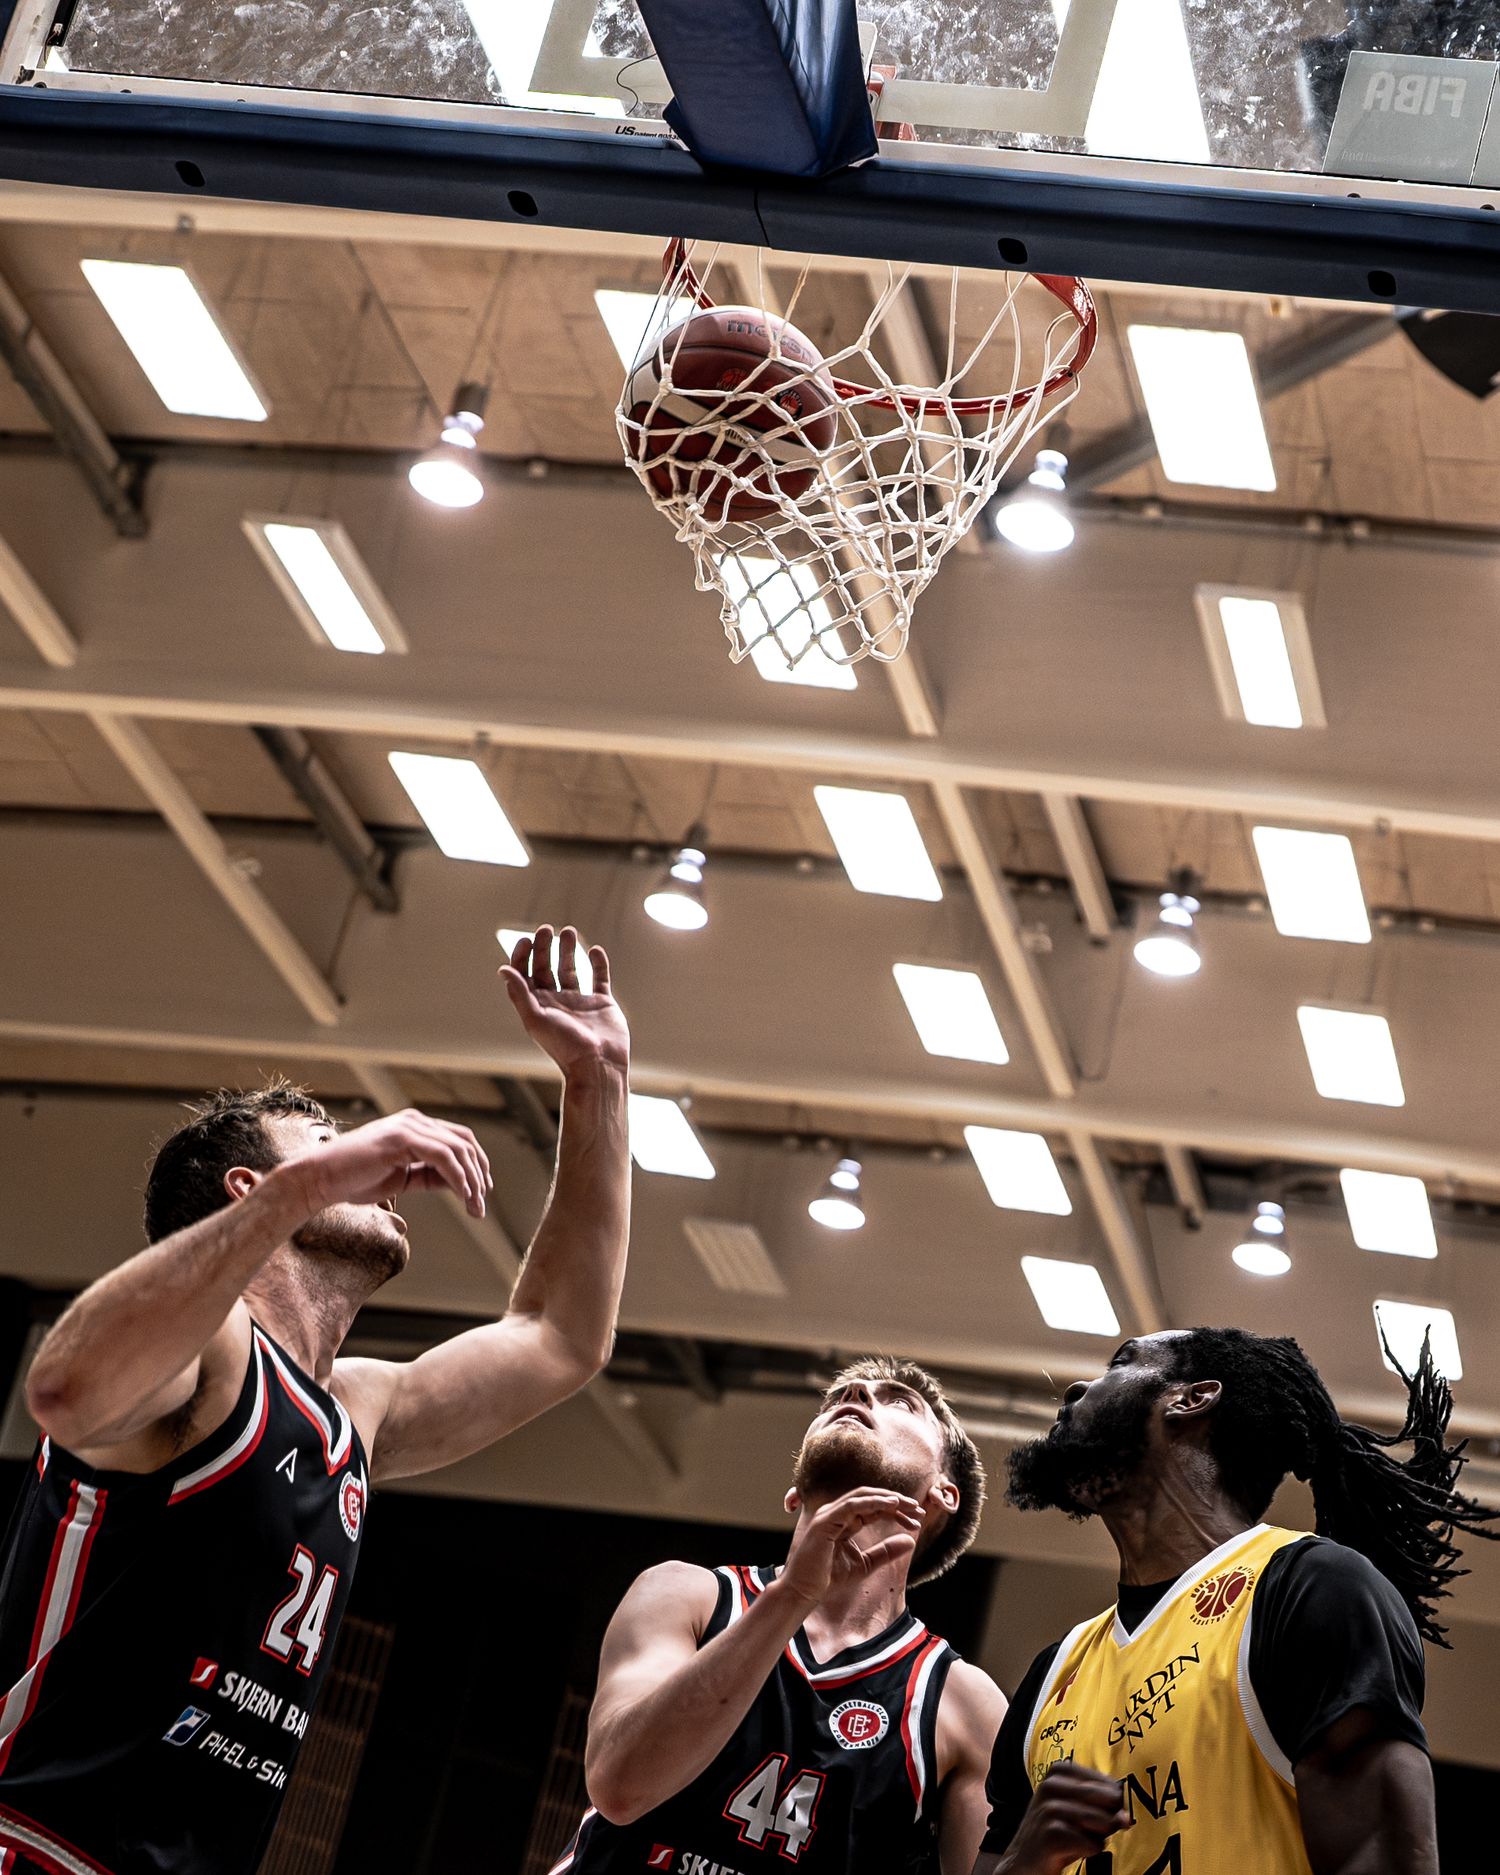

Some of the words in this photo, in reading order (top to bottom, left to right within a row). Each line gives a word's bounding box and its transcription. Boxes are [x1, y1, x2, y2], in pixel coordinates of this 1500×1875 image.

[615, 125, 636, 136] US
[260, 1543, 339, 1677] 24
[217, 1670, 284, 1724] SKJERN
[1127, 1683, 1176, 1754] NYT
[246, 1755, 259, 1770] &
[722, 1752, 828, 1864] 44
